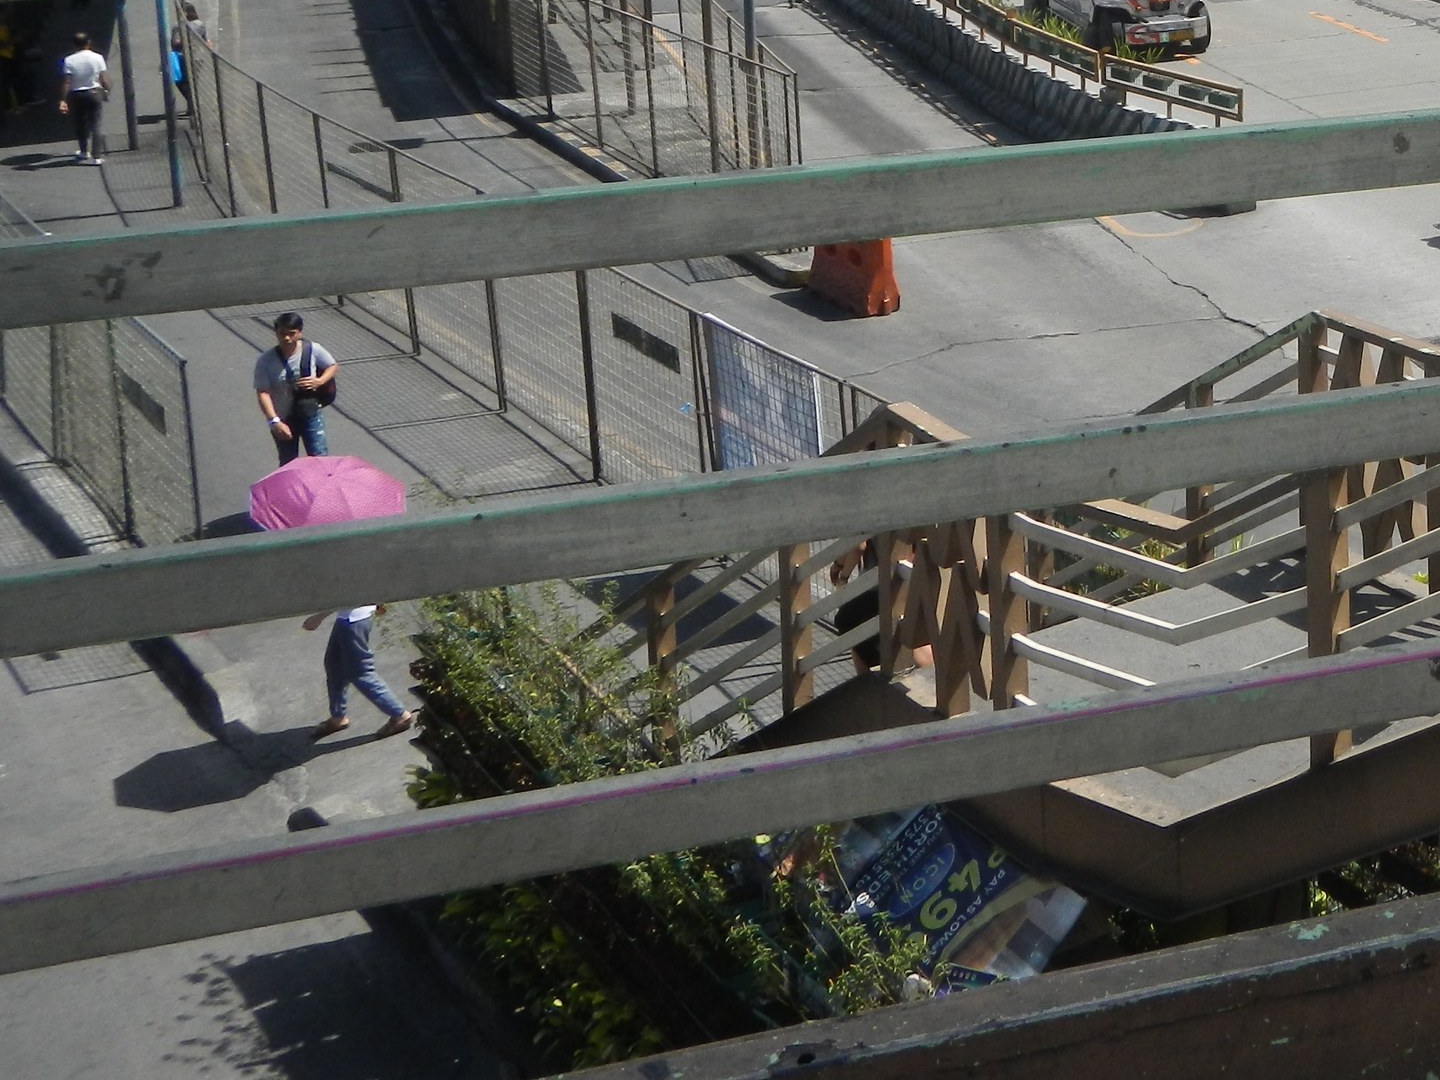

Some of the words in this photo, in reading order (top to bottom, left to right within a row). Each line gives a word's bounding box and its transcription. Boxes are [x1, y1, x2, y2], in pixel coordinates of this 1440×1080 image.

[845, 870, 891, 917] EDSA
[900, 857, 945, 905] ICON
[984, 869, 1006, 896] PAY
[966, 895, 982, 915] AS
[938, 914, 967, 945] LOW
